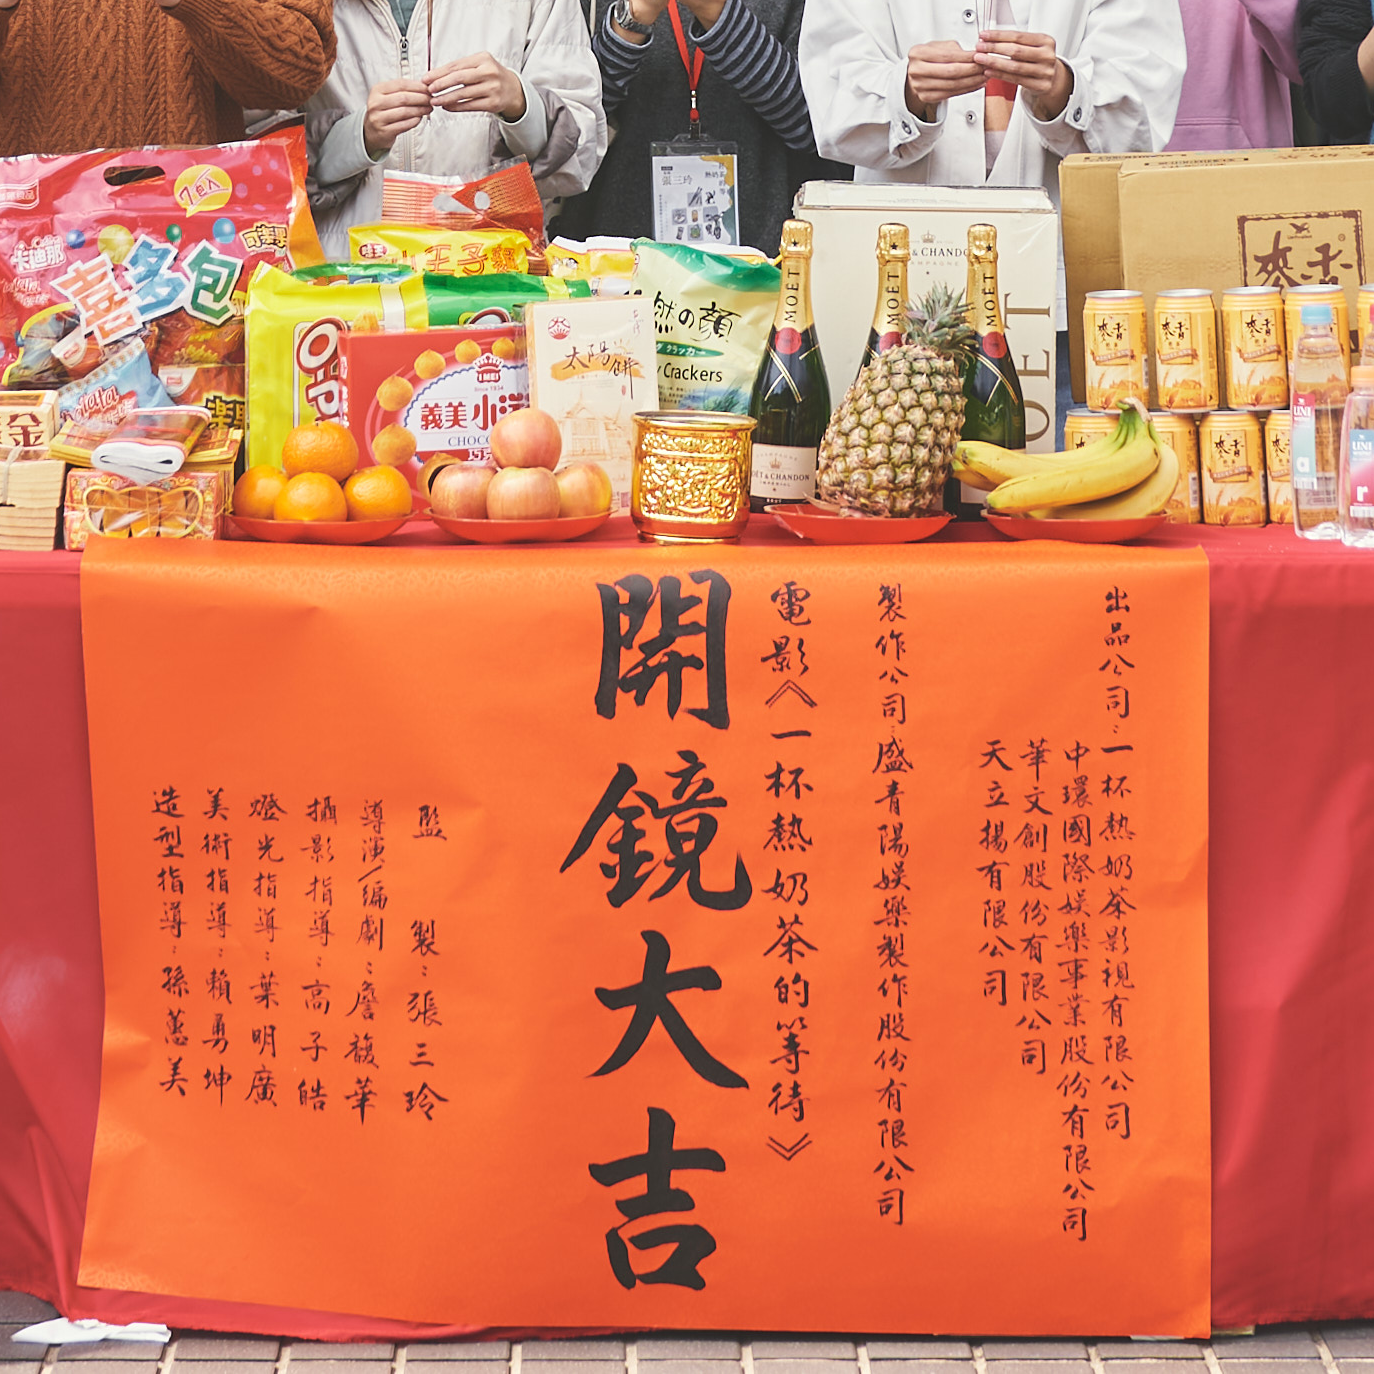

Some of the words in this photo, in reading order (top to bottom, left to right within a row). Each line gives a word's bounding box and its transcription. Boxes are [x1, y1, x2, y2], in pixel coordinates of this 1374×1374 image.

[241, 224, 288, 250] 可樂果
[50, 234, 243, 346] 喜多包
[562, 340, 639, 401] 太陽餅
[664, 363, 723, 382] Crackers
[421, 401, 468, 431] 義美
[1294, 407, 1311, 417] UNI
[1352, 441, 1372, 451] UNI
[771, 472, 810, 481] CHANDON
[1356, 485, 1369, 502] r
[760, 581, 819, 1162] 電影《一杯熱奶茶的等待》
[976, 739, 1016, 1007] 天立揚有限公司
[1013, 737, 1054, 1075] 華文創股份有限公司
[559, 568, 754, 1292] 開鏡大吉
